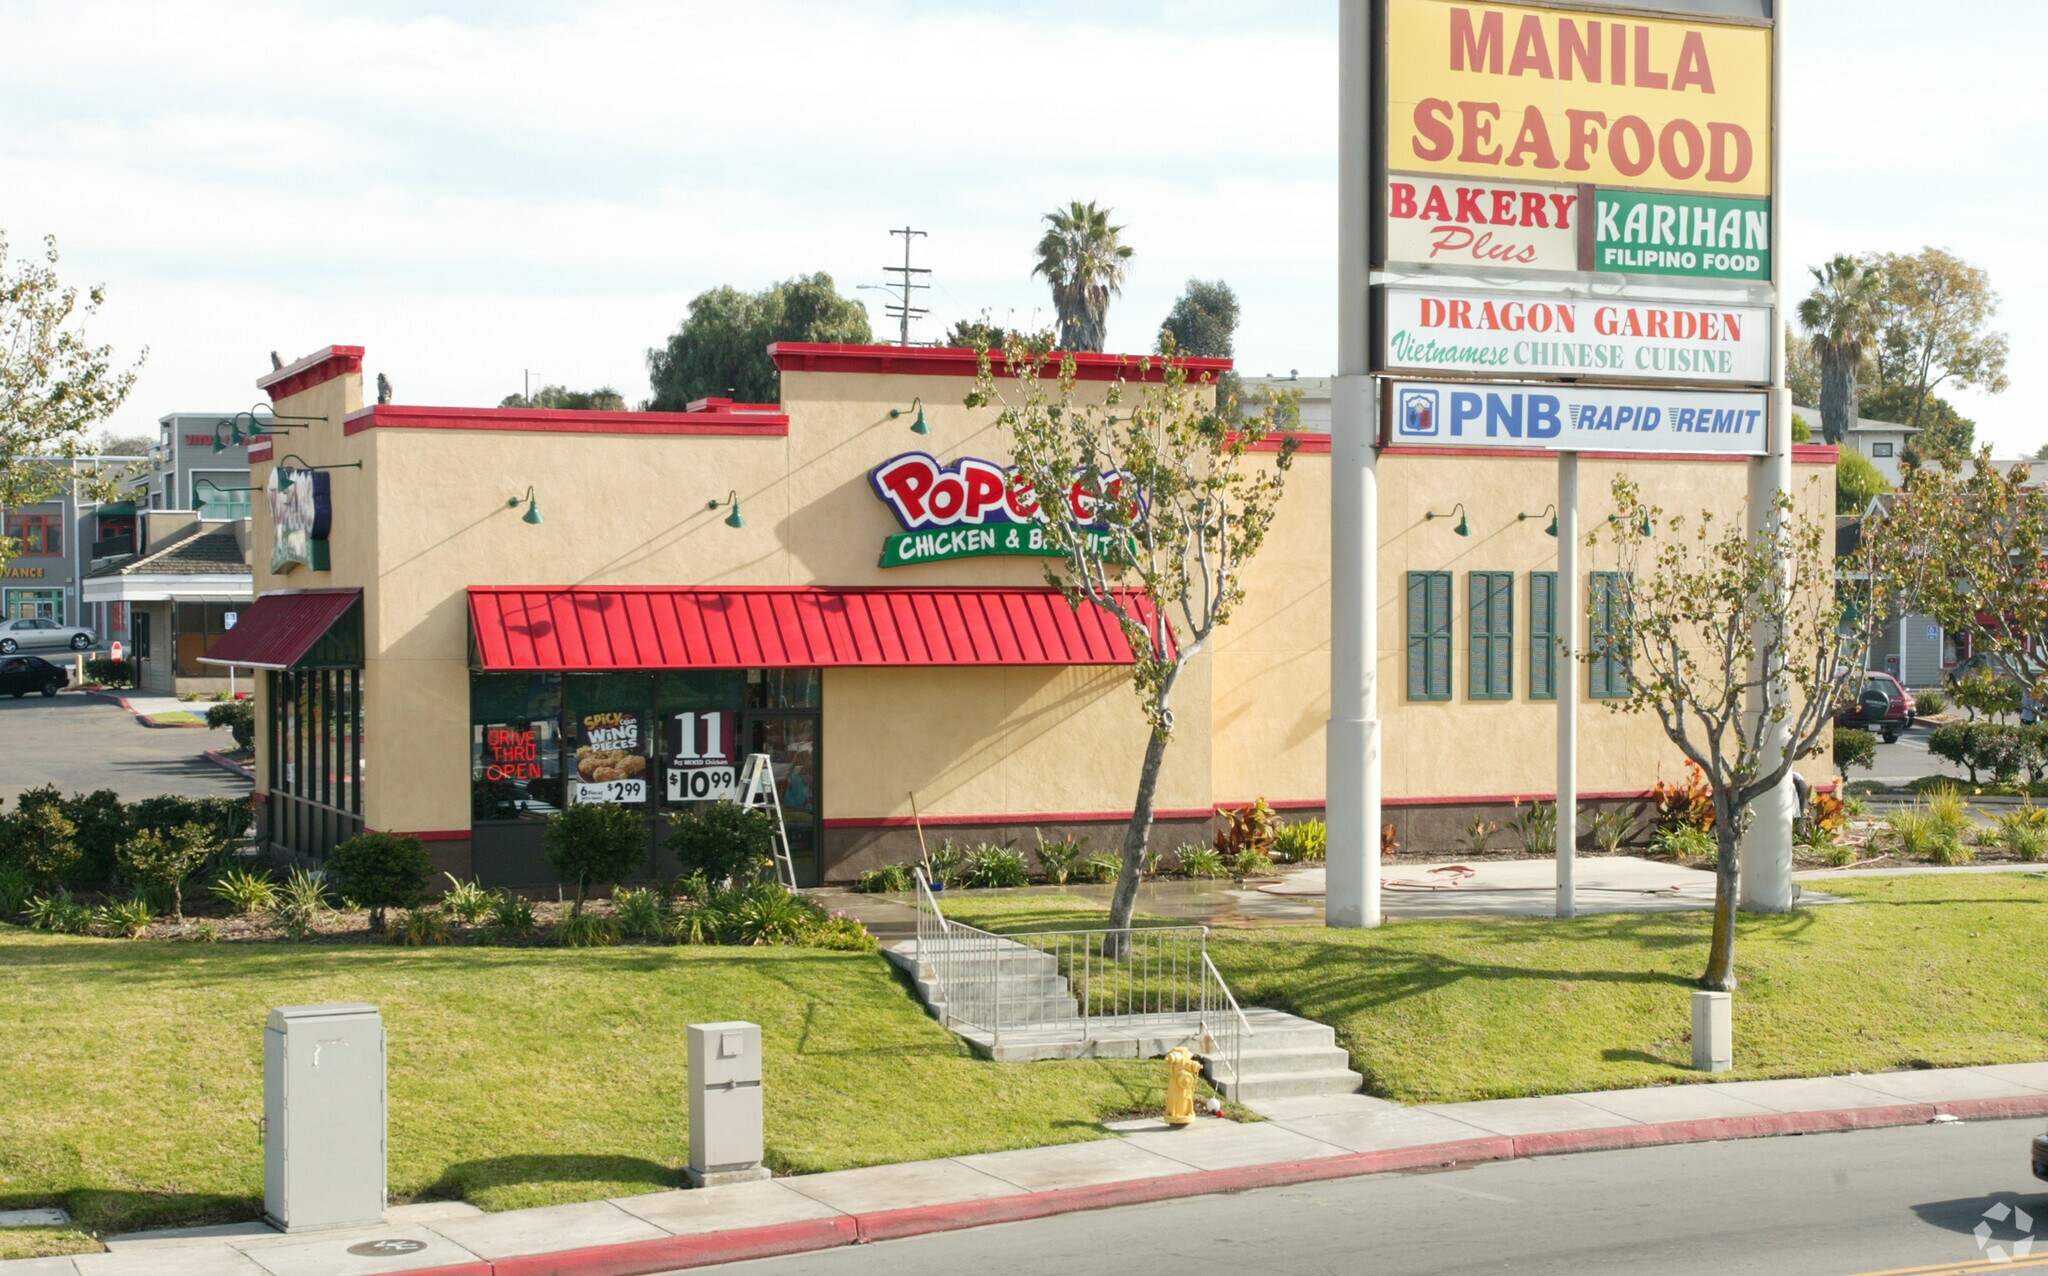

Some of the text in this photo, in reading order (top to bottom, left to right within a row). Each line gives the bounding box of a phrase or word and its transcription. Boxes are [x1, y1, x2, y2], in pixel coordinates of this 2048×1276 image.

[1450, 7, 1715, 94] MANILA
[1412, 97, 1753, 183] SEAFOOD
[1389, 182, 1577, 229] BAKERY
[1596, 201, 1768, 250] KARIHAN
[1429, 225, 1538, 263] Plus
[1604, 248, 1760, 272] FILIPINO FOOD
[1419, 298, 1743, 342] DRAGON GARDEN
[1391, 330, 1733, 374] Vietnamese CHINESE CUISINE
[1450, 391, 1762, 439] PNB RAPID REMIT
[899, 528, 996, 560] CHICKEN
[1004, 527, 1020, 549] &
[488, 730, 536, 746] DRIVE
[492, 744, 536, 762] THRU
[592, 738, 638, 753] PIECES
[675, 712, 726, 758] 11
[487, 764, 542, 781] OPEN
[580, 786, 588, 797] 6
